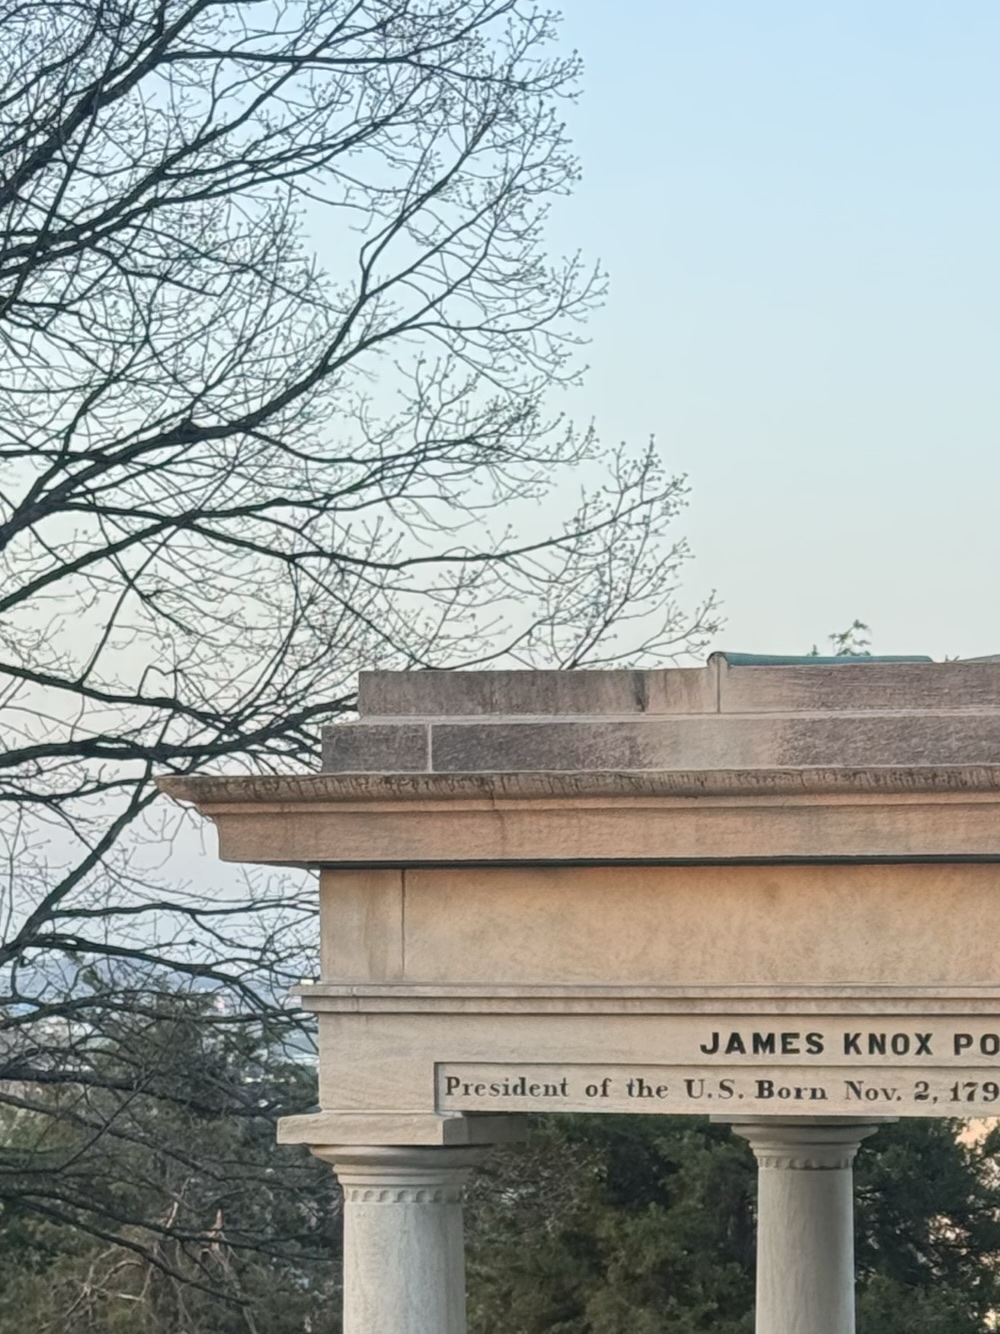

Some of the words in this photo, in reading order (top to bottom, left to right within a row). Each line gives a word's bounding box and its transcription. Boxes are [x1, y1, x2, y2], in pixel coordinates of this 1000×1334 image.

[700, 1032, 825, 1055] JAMES
[843, 1032, 934, 1056] KNOX
[445, 1076, 569, 1098] President
[585, 1078, 612, 1098] of
[627, 1077, 669, 1099] the
[684, 1079, 744, 1099] U.S.
[755, 1079, 829, 1101] Born
[844, 1080, 901, 1102] Nov.
[914, 1081, 938, 1104] 2,
